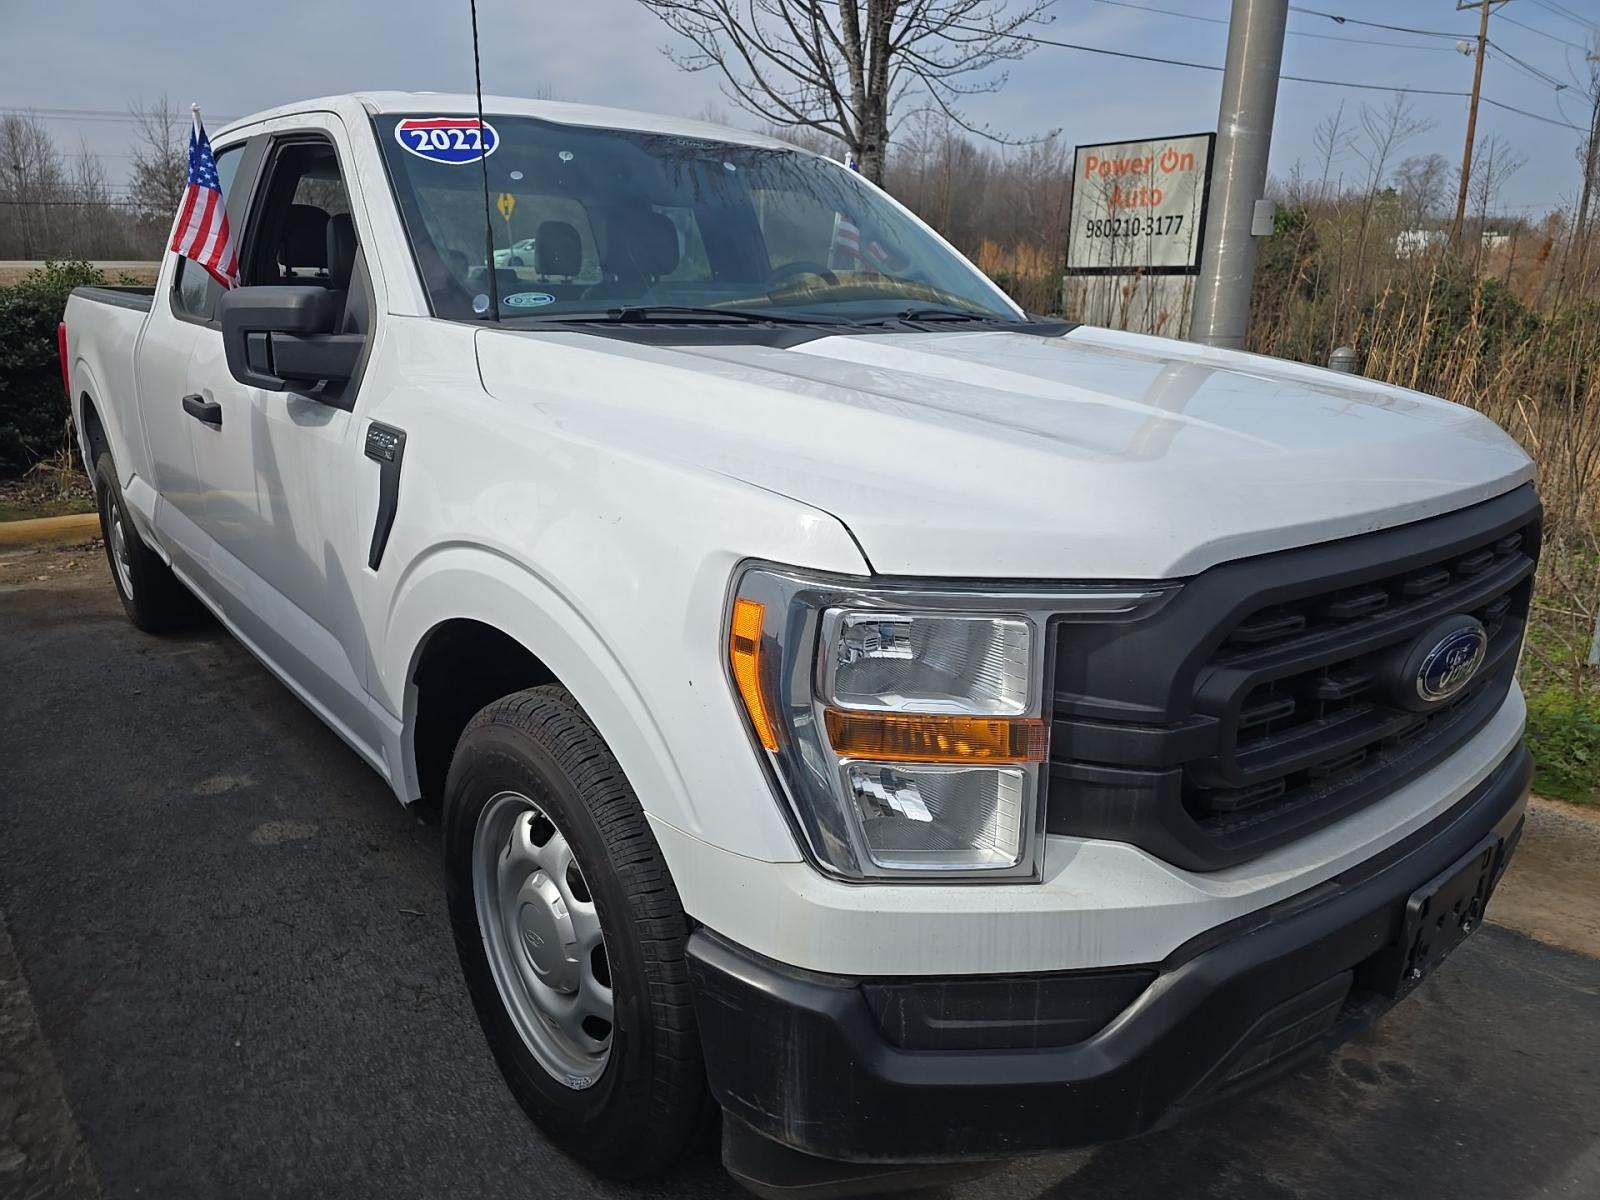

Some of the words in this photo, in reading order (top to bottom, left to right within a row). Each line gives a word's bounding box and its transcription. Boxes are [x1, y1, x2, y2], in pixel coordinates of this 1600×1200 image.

[410, 128, 490, 151] 2022
[1084, 154, 1155, 180] Power
[1160, 147, 1195, 174] On
[1107, 185, 1164, 209] Auto
[1439, 643, 1478, 688] Ford
